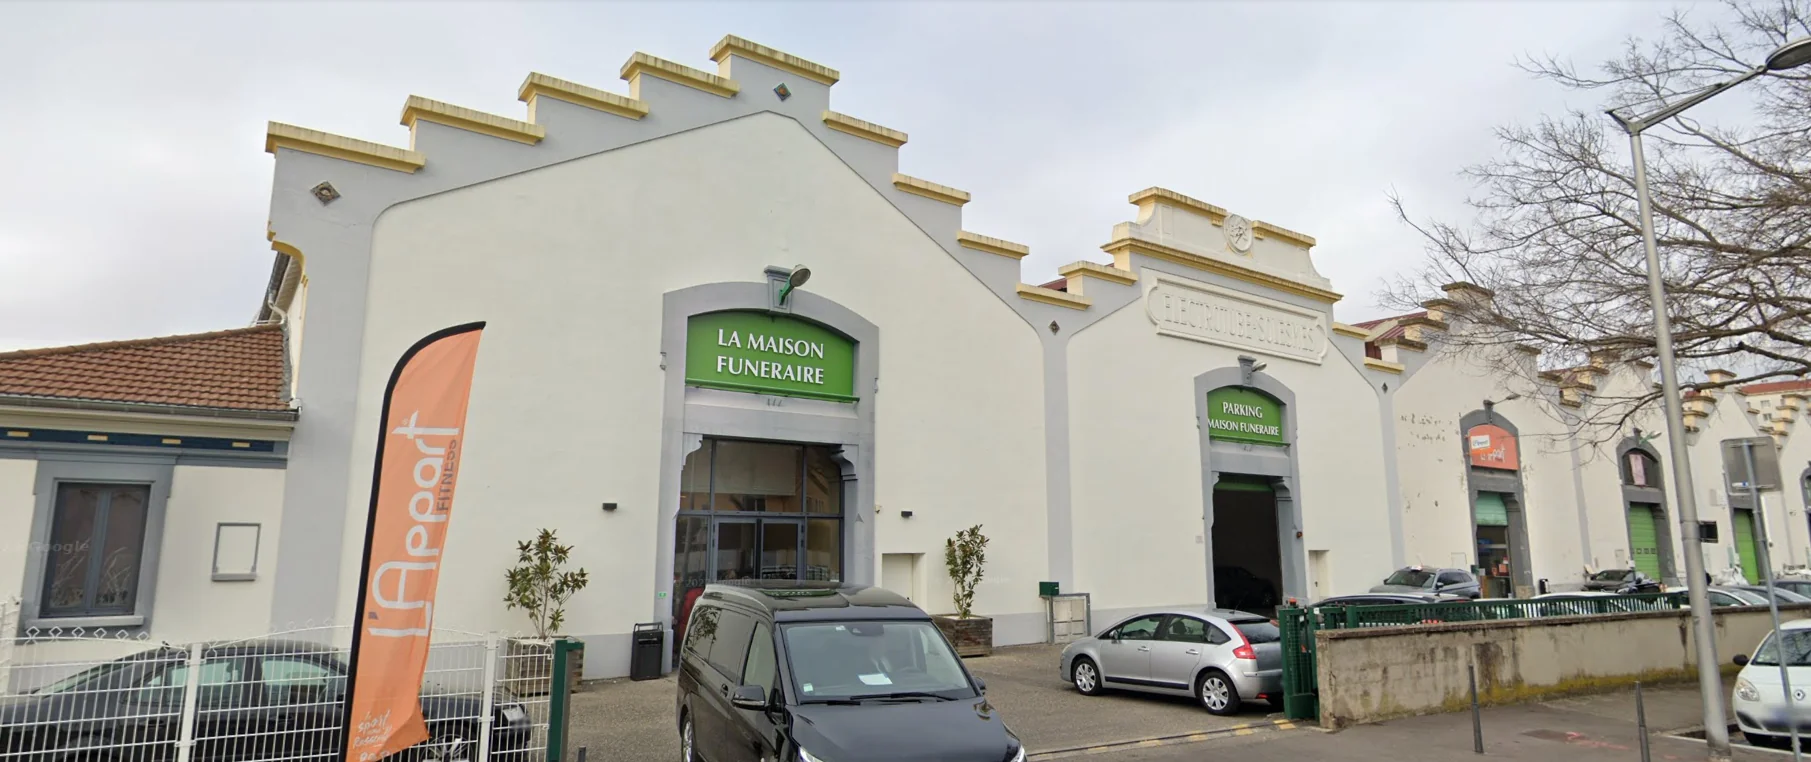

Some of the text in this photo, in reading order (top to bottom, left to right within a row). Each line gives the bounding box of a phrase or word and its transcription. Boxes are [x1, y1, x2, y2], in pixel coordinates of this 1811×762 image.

[718, 328, 824, 359] LA MAISON
[716, 356, 824, 384] FUNERAIRE
[1222, 401, 1263, 419] PARKING
[1207, 418, 1280, 436] MAISON FUNERAIRE
[436, 439, 458, 512] FITNESS
